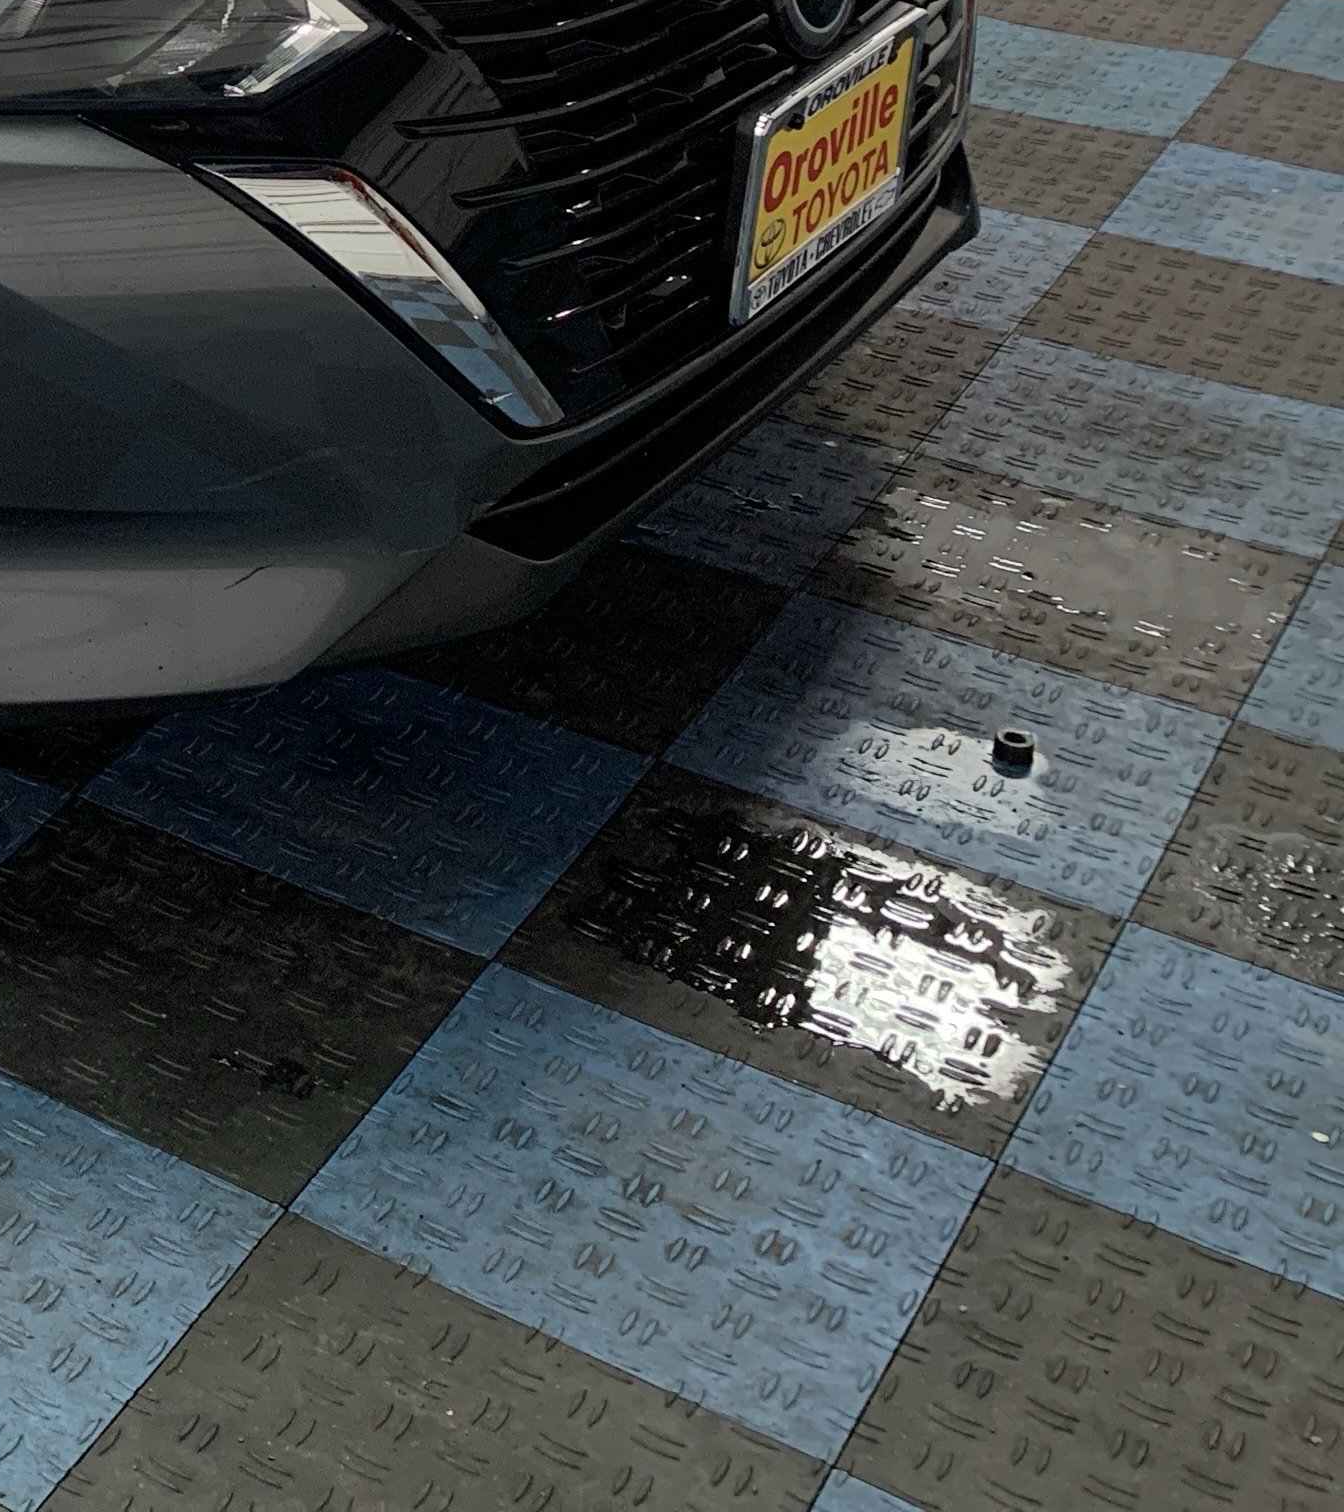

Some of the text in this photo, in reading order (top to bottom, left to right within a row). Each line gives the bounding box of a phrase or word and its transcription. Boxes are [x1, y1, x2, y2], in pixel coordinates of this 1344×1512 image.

[763, 81, 899, 214] Oroville
[792, 139, 889, 245] TOYOTA
[768, 197, 875, 299] TOYOTA CHEVROLET
